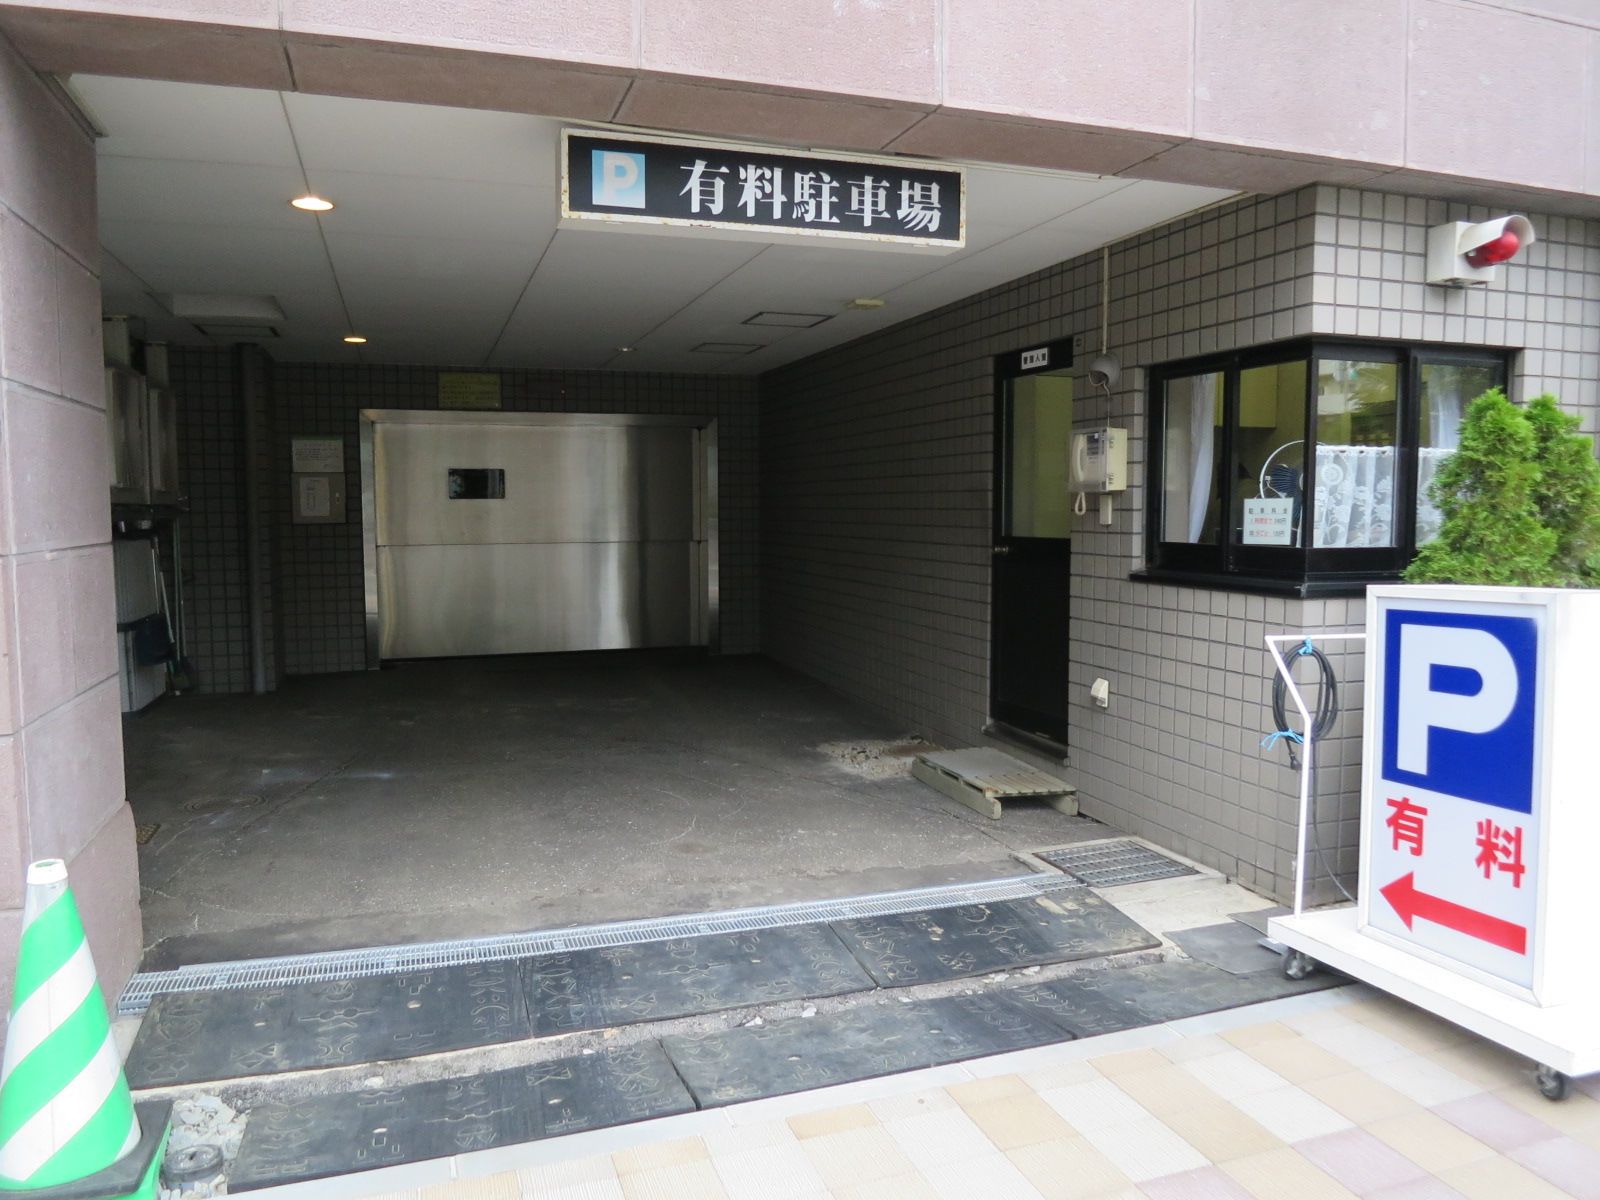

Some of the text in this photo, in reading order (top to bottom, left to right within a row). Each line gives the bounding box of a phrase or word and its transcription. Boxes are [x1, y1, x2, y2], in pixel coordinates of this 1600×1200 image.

[603, 154, 942, 232] P 有料駐車場
[1397, 623, 1518, 776] P
